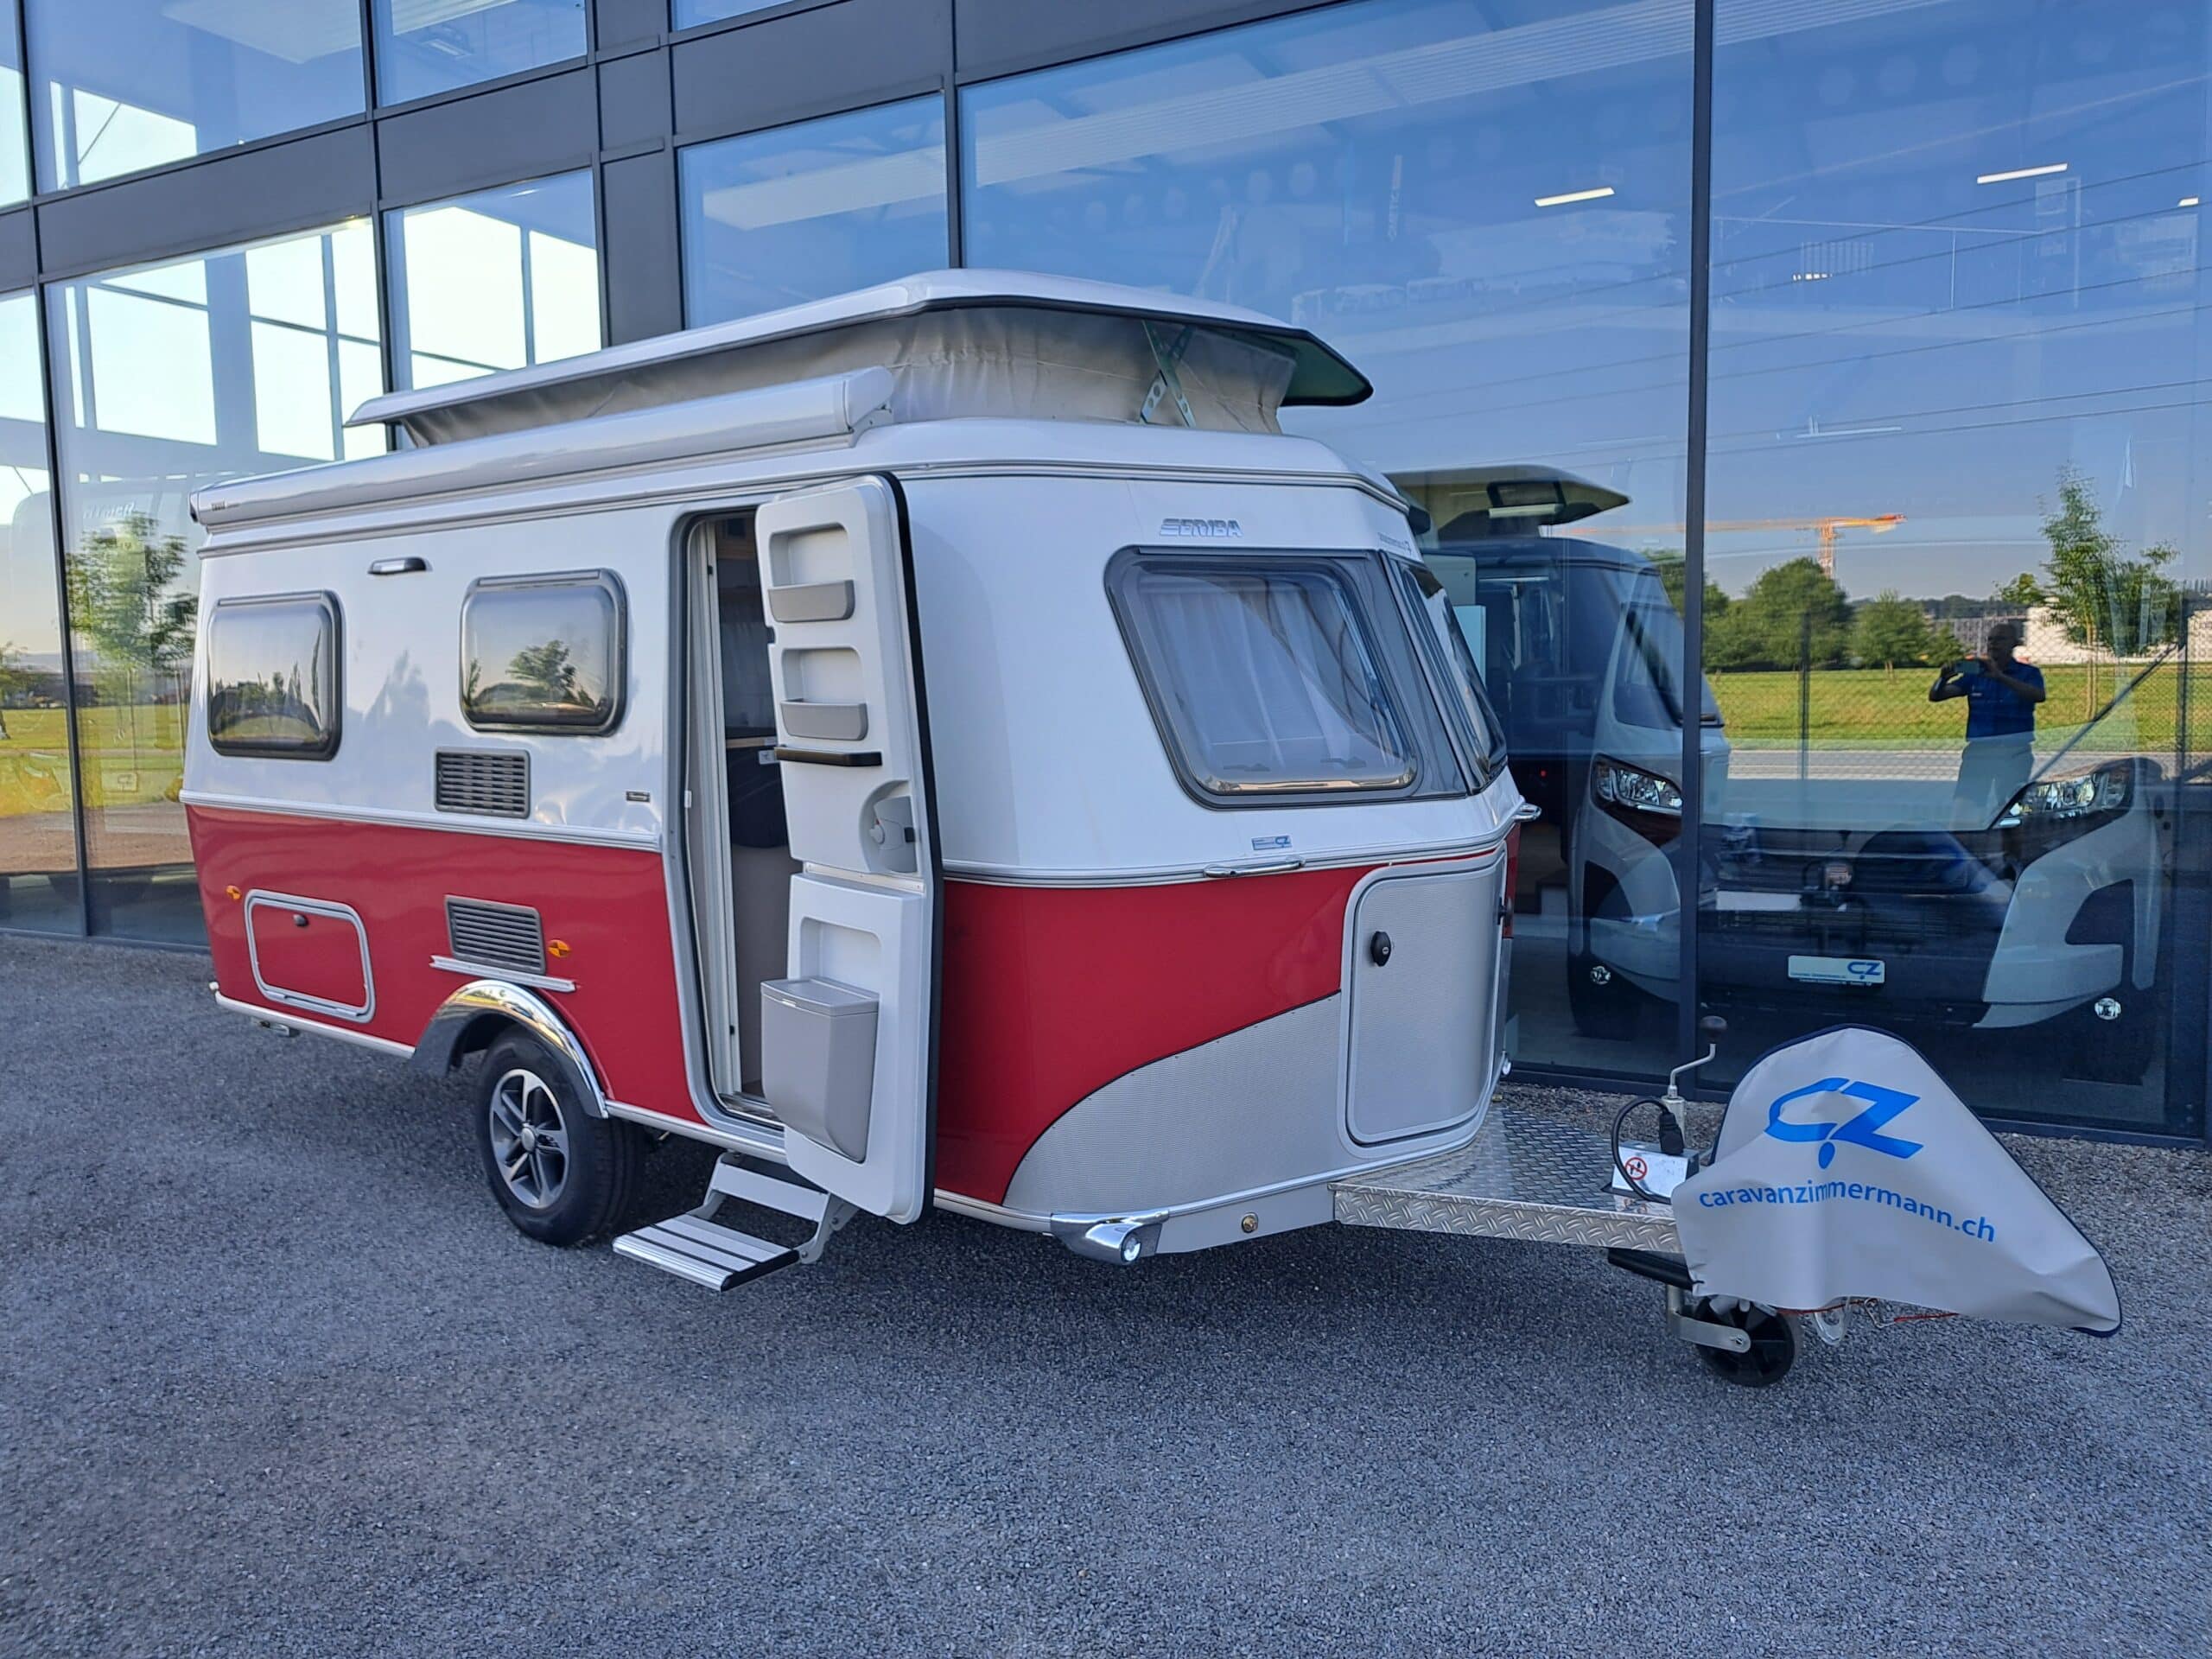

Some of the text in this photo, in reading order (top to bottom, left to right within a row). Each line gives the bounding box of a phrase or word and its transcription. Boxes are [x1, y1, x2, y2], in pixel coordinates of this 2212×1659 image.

[1847, 961, 1881, 980] CZ
[1764, 1077, 1924, 1169] CZ
[1699, 1179, 1995, 1242] caravanzimmermann.ch
